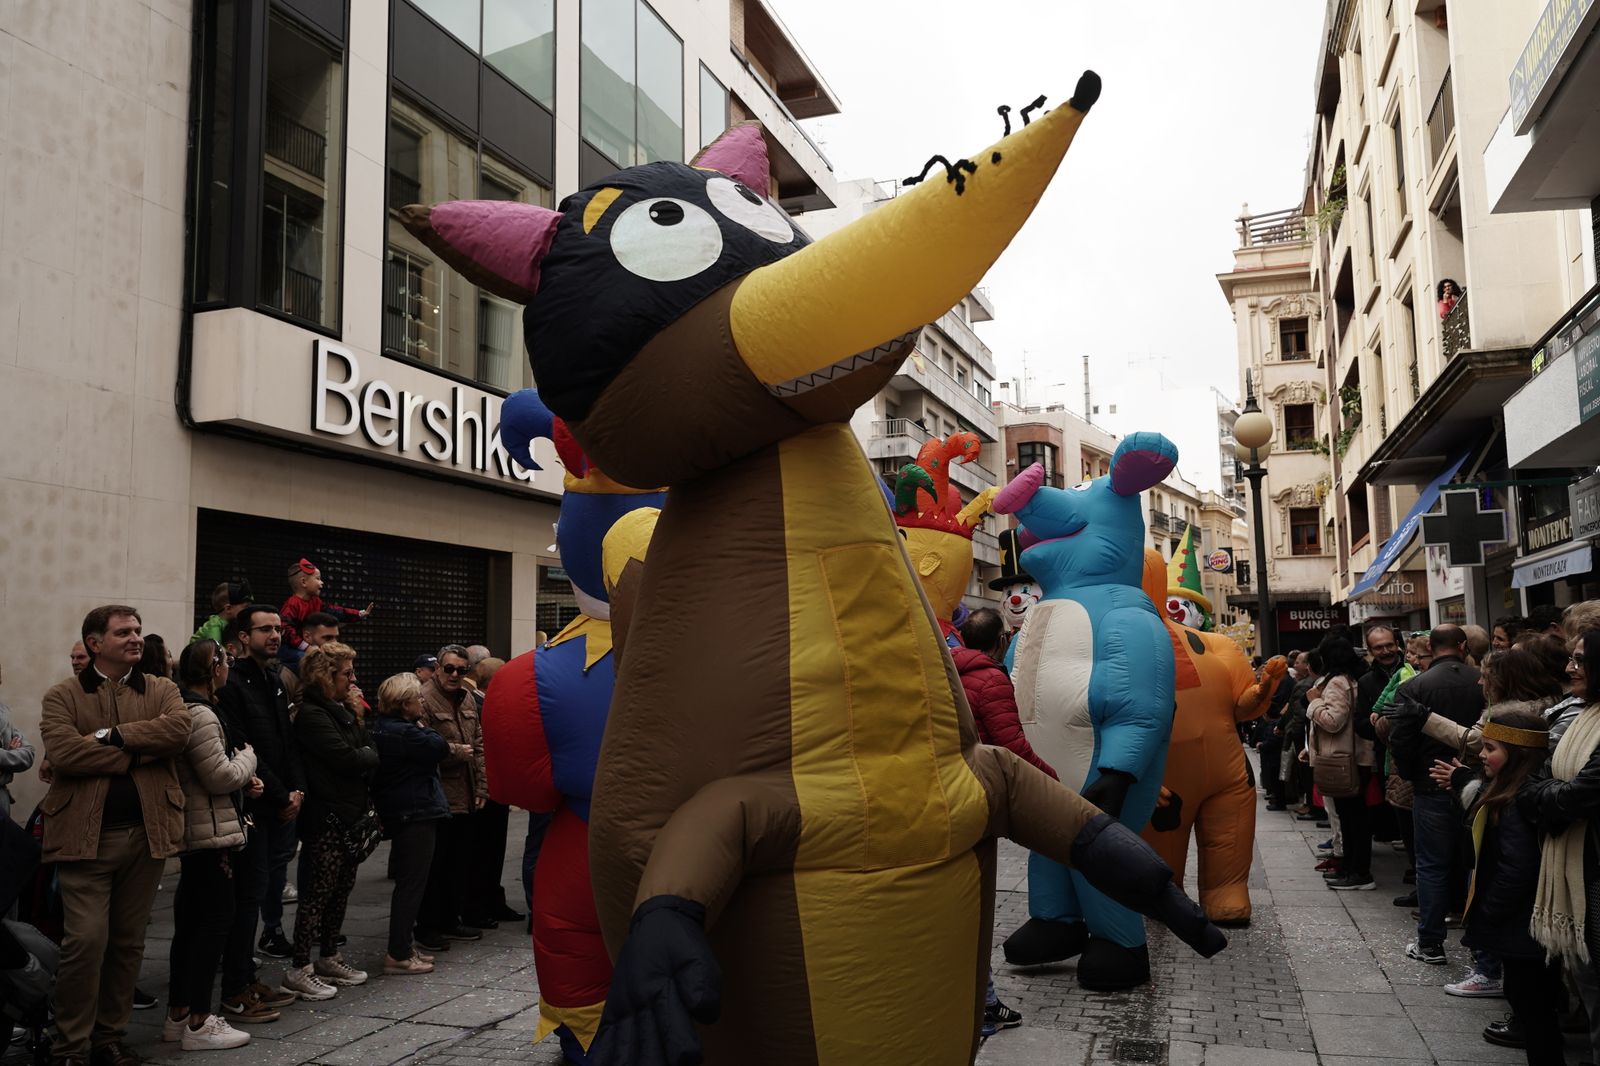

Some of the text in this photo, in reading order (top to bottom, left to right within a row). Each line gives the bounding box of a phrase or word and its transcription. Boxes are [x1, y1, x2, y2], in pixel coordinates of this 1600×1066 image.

[1550, 10, 1577, 66] ALQUILER
[1211, 558, 1229, 567] KING
[1289, 609, 1340, 620] BURGER
[1299, 619, 1331, 630] KING
